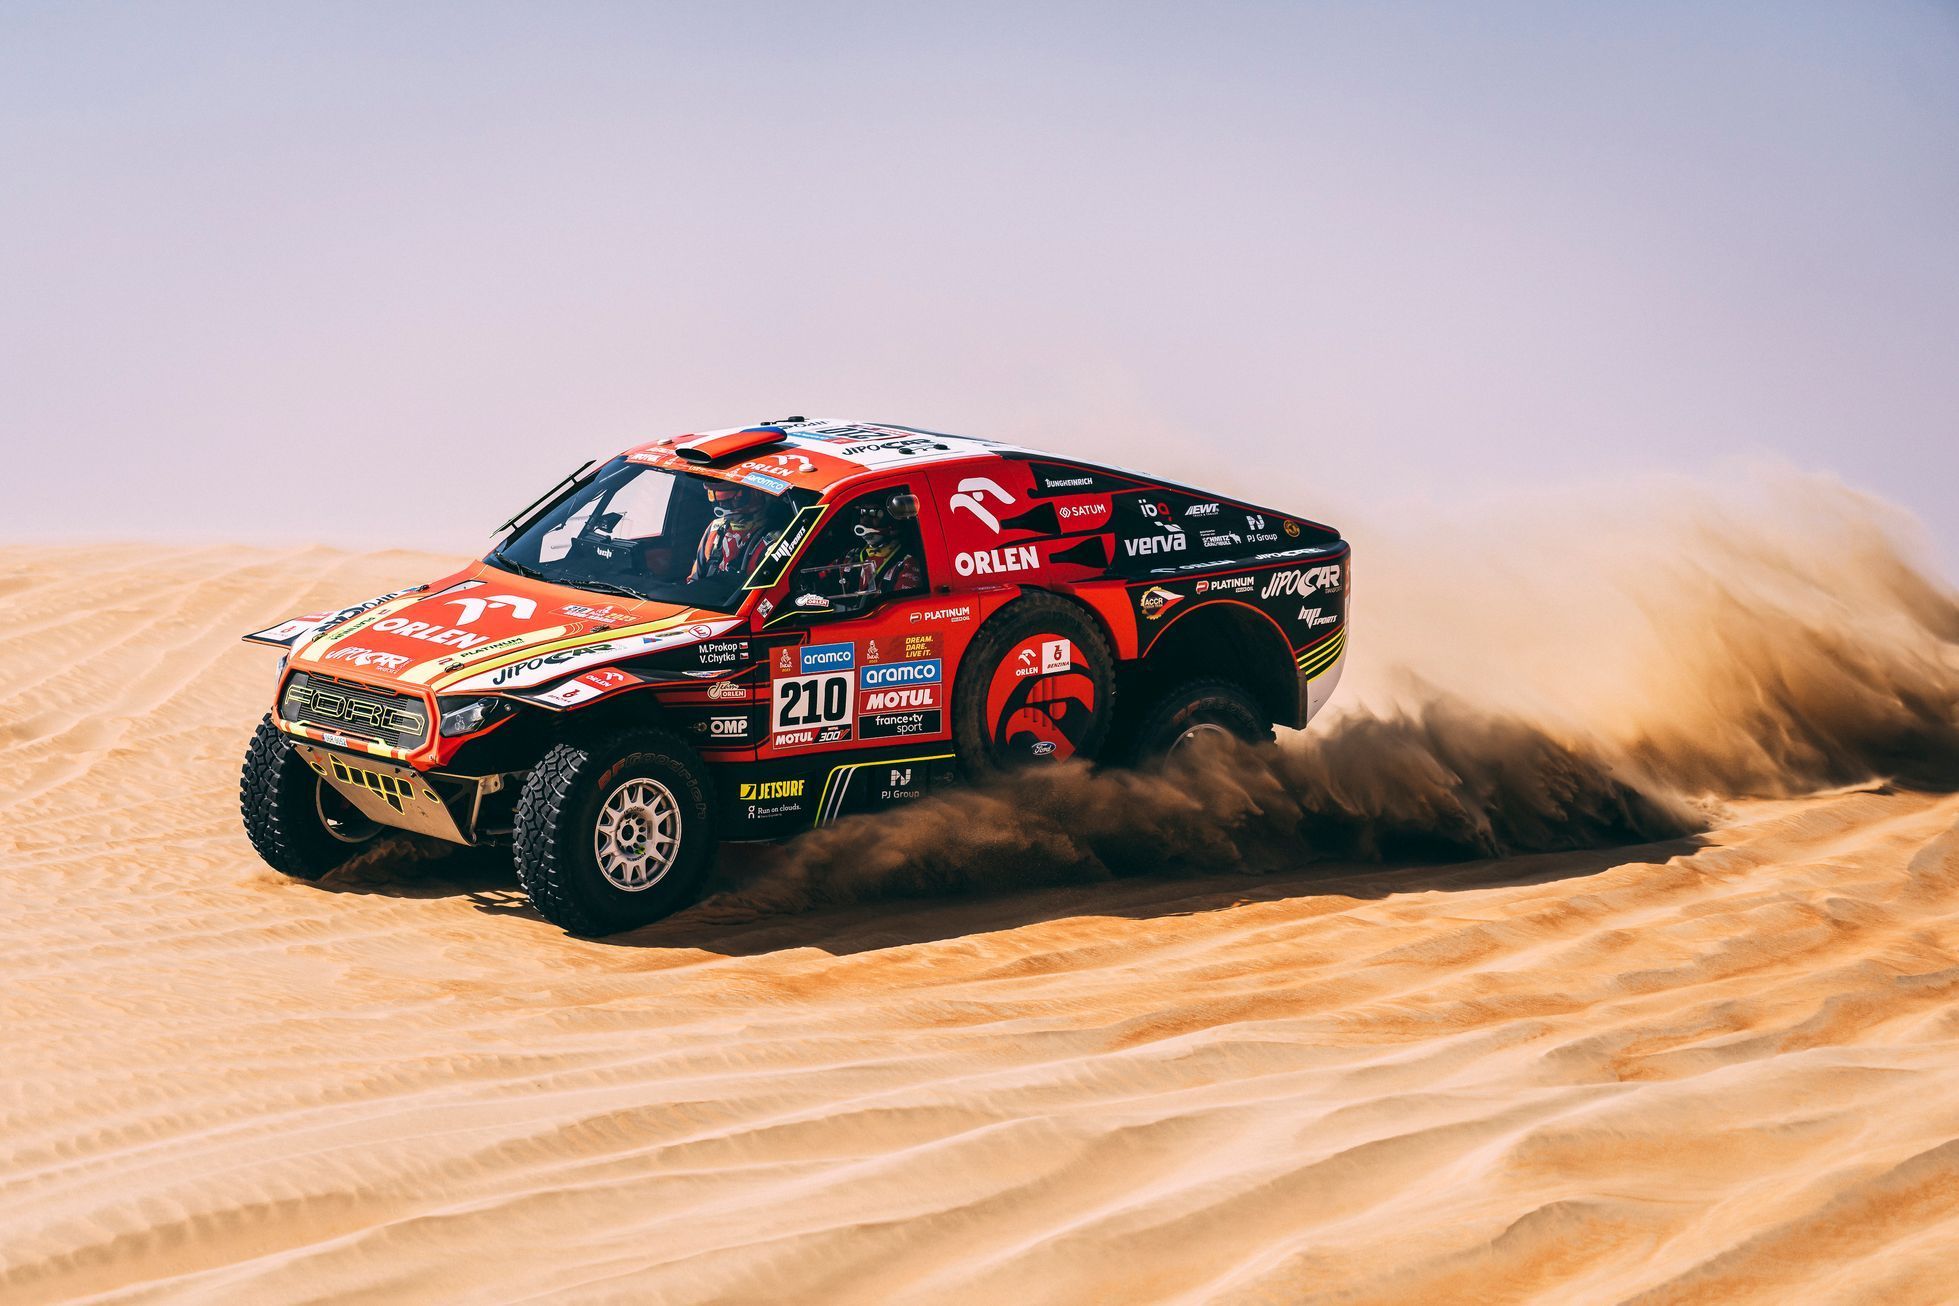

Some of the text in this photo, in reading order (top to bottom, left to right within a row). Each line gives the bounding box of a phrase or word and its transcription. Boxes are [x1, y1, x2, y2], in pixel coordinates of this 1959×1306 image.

[741, 462, 795, 477] ORLEN
[747, 474, 784, 490] aramco
[1072, 503, 1106, 516] SATUM
[1124, 533, 1187, 557] verva
[1246, 533, 1278, 542] PJ Group
[954, 545, 1041, 577] ORLEN
[1211, 576, 1254, 591] PLATINUM
[1144, 597, 1164, 606] ACCR
[923, 606, 970, 621] PLATINUM
[1312, 614, 1338, 626] SPORTS
[372, 616, 491, 650] ORLEN
[905, 636, 934, 645] DREAM.
[460, 637, 524, 658] PLATINUM
[905, 644, 928, 652] DARE.
[804, 651, 852, 665] aramco
[1046, 661, 1070, 670] BENZINA
[866, 664, 936, 684] aramco
[1015, 666, 1039, 677] ORLEN
[585, 674, 613, 688] ORLEN
[721, 690, 745, 698] ORLEN
[779, 676, 847, 727] 210
[865, 688, 934, 711] MOTUL
[285, 684, 426, 737] FORD
[710, 719, 748, 735] OMP
[896, 722, 923, 736] sport
[775, 731, 814, 746] MOTUL
[758, 779, 805, 800] JETSURF
[881, 790, 920, 799] PJ Group
[757, 806, 771, 815] Run
[779, 803, 801, 812] clouds.
